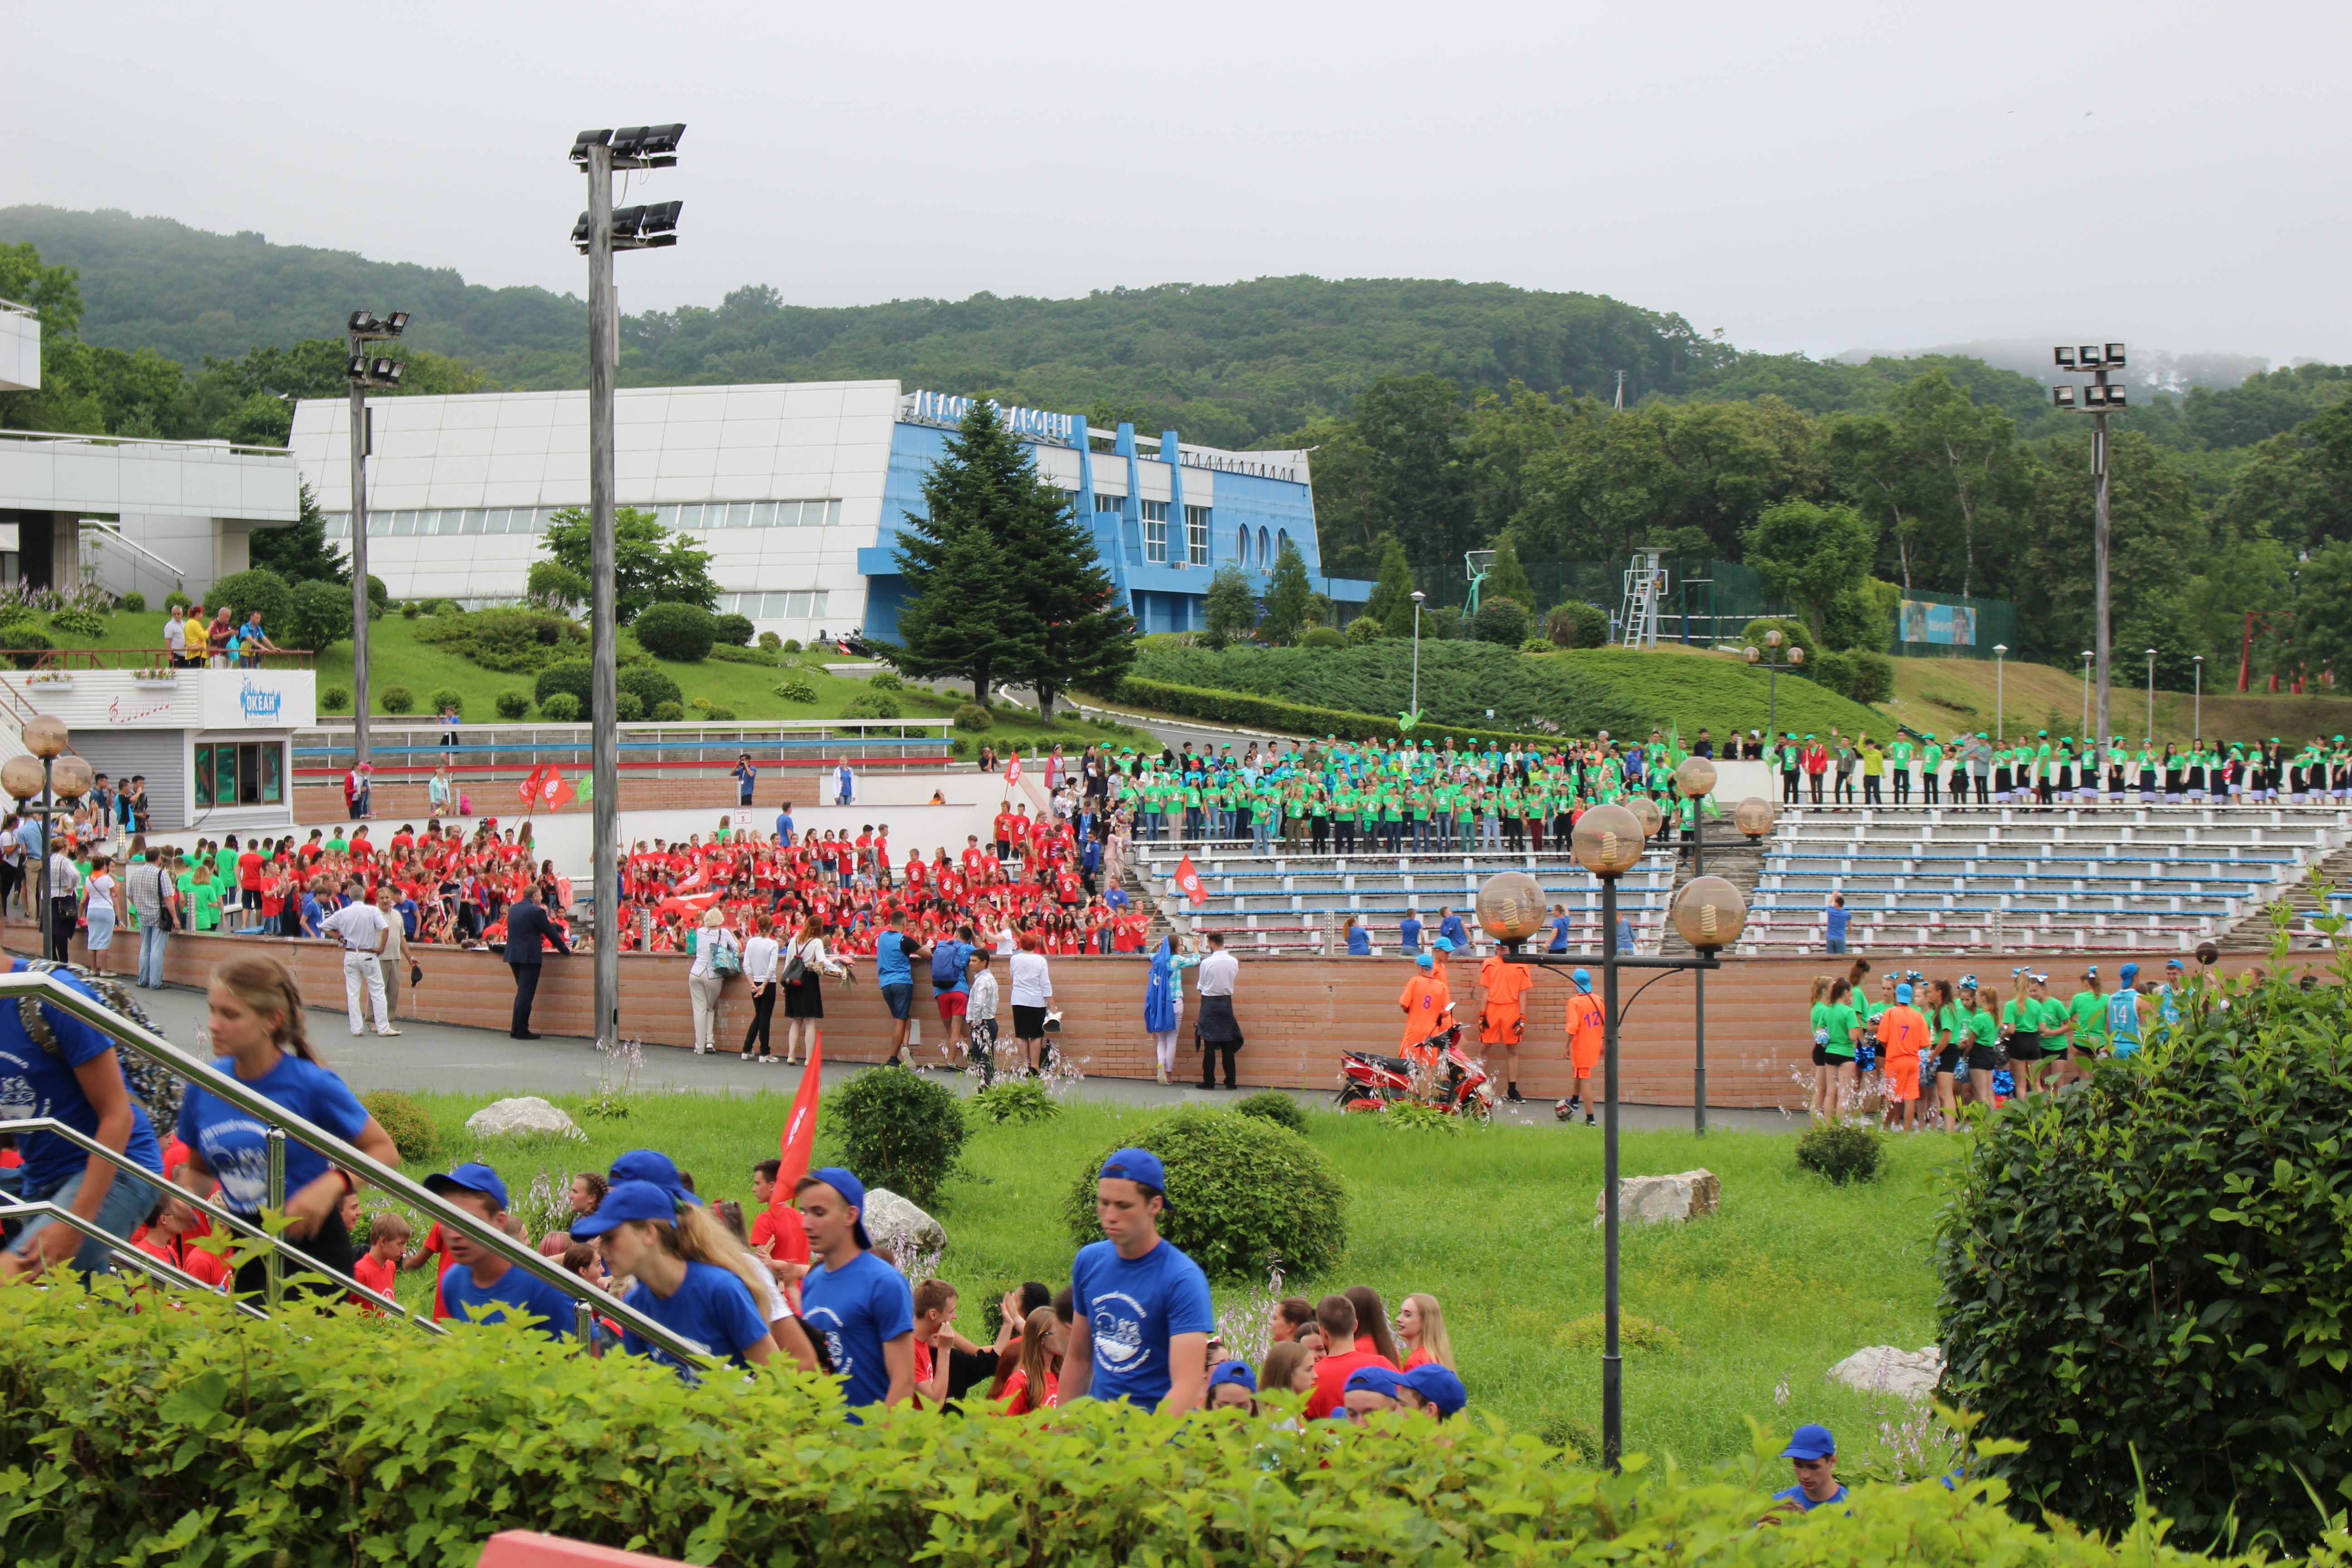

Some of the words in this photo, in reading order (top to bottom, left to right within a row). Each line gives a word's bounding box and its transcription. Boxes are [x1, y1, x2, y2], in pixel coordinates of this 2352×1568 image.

[914, 389, 1000, 424] ЛЕДОВЙ
[1009, 406, 1075, 444] ДВОРЕЦ
[246, 695, 274, 711] ОКЕАН
[1423, 995, 1431, 1009] 8
[1584, 1011, 1600, 1028] 12
[2112, 1004, 2128, 1024] 14
[1901, 1026, 1909, 1040] 7
